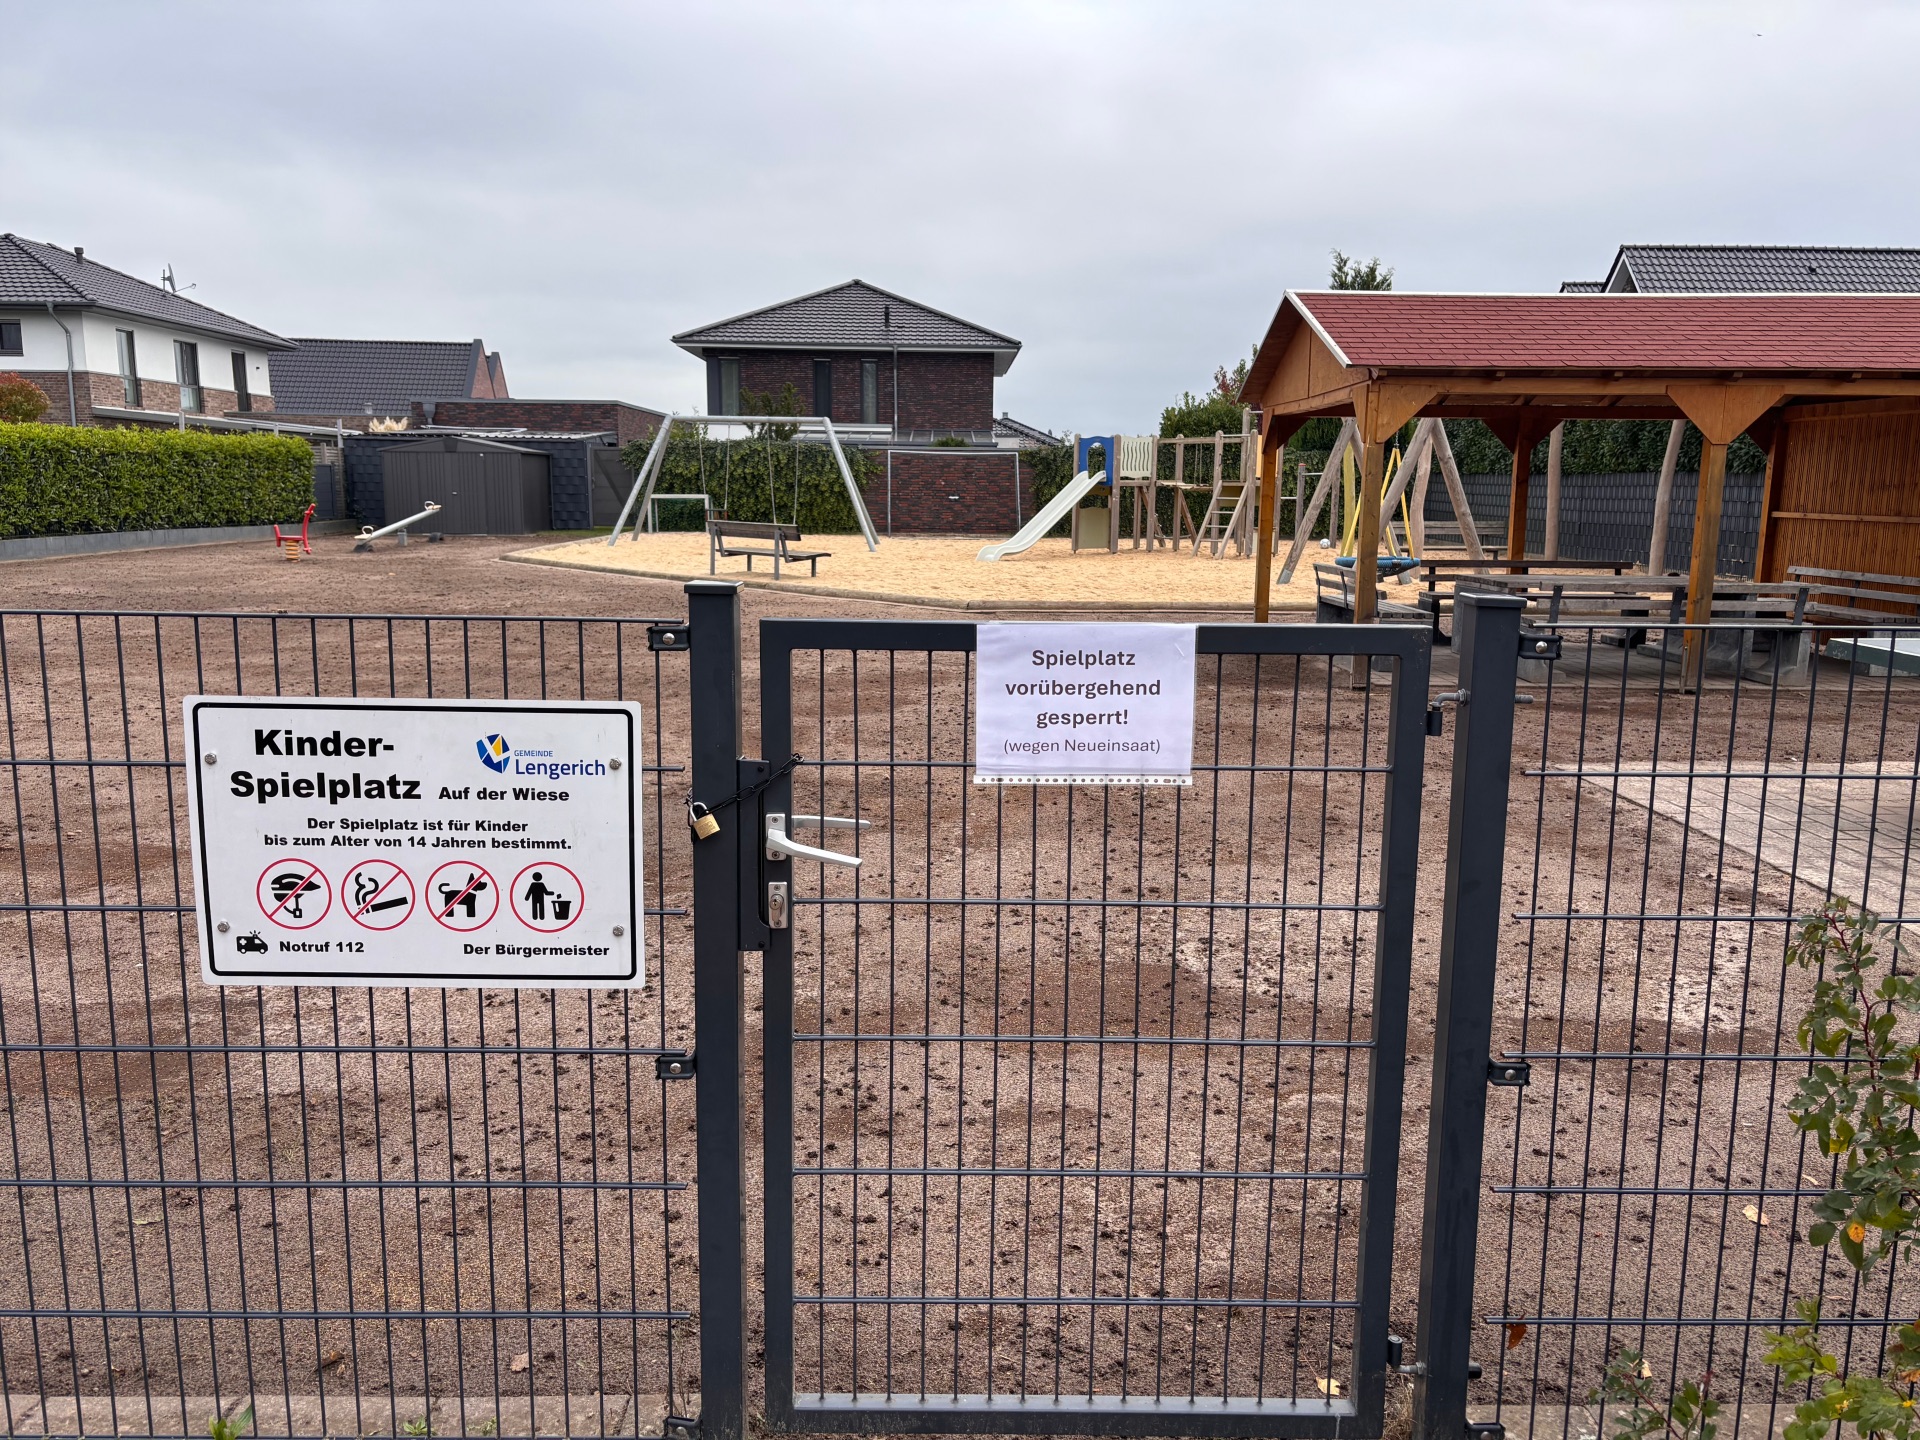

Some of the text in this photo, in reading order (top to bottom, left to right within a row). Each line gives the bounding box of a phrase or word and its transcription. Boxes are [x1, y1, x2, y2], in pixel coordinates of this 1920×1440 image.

[1031, 649, 1136, 670] Spielplatz
[1004, 679, 1161, 700] vorübergehend
[1036, 709, 1128, 729] gesperrt!
[254, 728, 395, 758] Kinder-
[1004, 738, 1161, 755] (wegen Neueinsaat)
[513, 749, 554, 758] GEMEINDE
[515, 758, 606, 781] Lengerich
[230, 770, 422, 806] Spielplatz
[438, 786, 570, 802] Auf der Wiese
[307, 817, 529, 833] Der Spielplatz ist für Kinder
[263, 834, 572, 850] bis zum Alter von 14 Jahren bestimmt.
[279, 940, 365, 953] Notruf 112
[463, 943, 610, 959] Der Bürgermeister
